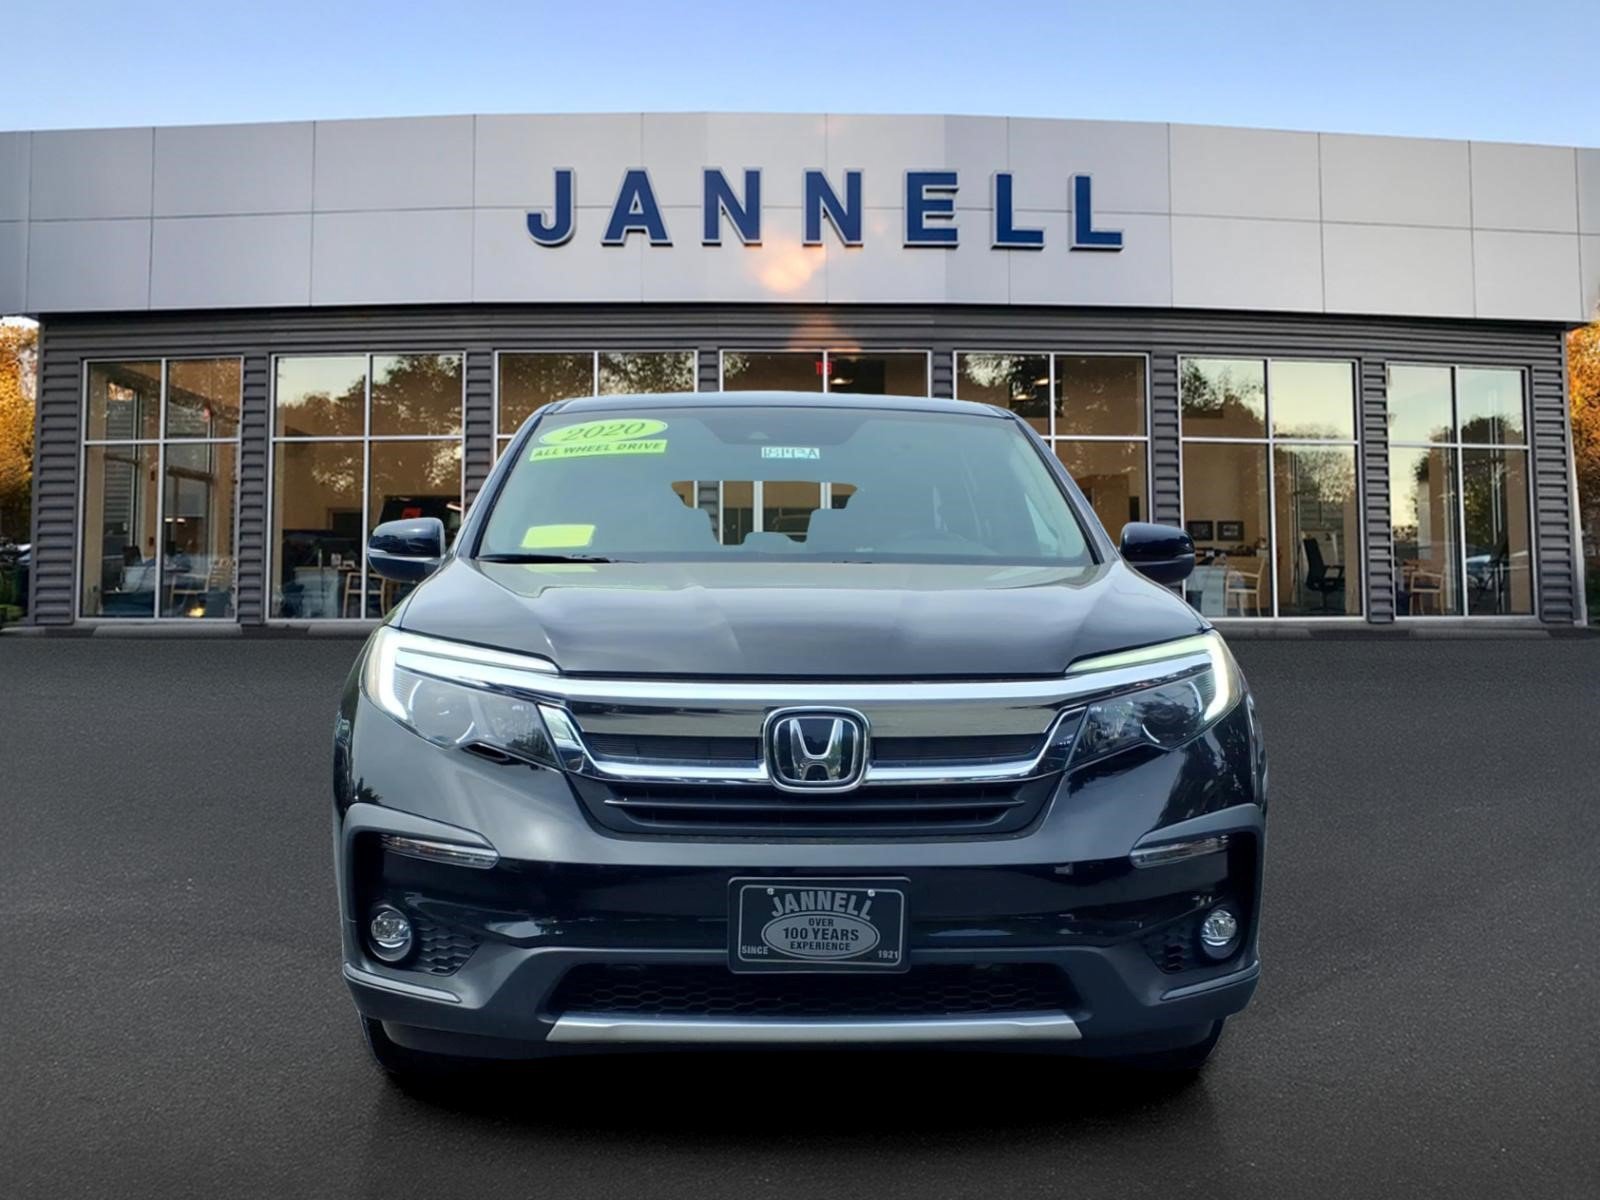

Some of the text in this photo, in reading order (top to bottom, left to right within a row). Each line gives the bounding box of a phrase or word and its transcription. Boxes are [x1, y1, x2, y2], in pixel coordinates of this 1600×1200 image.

[525, 167, 1124, 249] JANNELL
[561, 421, 646, 442] 2020
[534, 441, 664, 457] ALL WHEEL DRIVE
[771, 890, 873, 921] JANNELL
[808, 917, 834, 927] OVER
[783, 927, 860, 941] 100 YEARS
[741, 945, 769, 955] SINCE
[790, 940, 851, 951] EXPERIENCE
[877, 950, 899, 959] 1921
